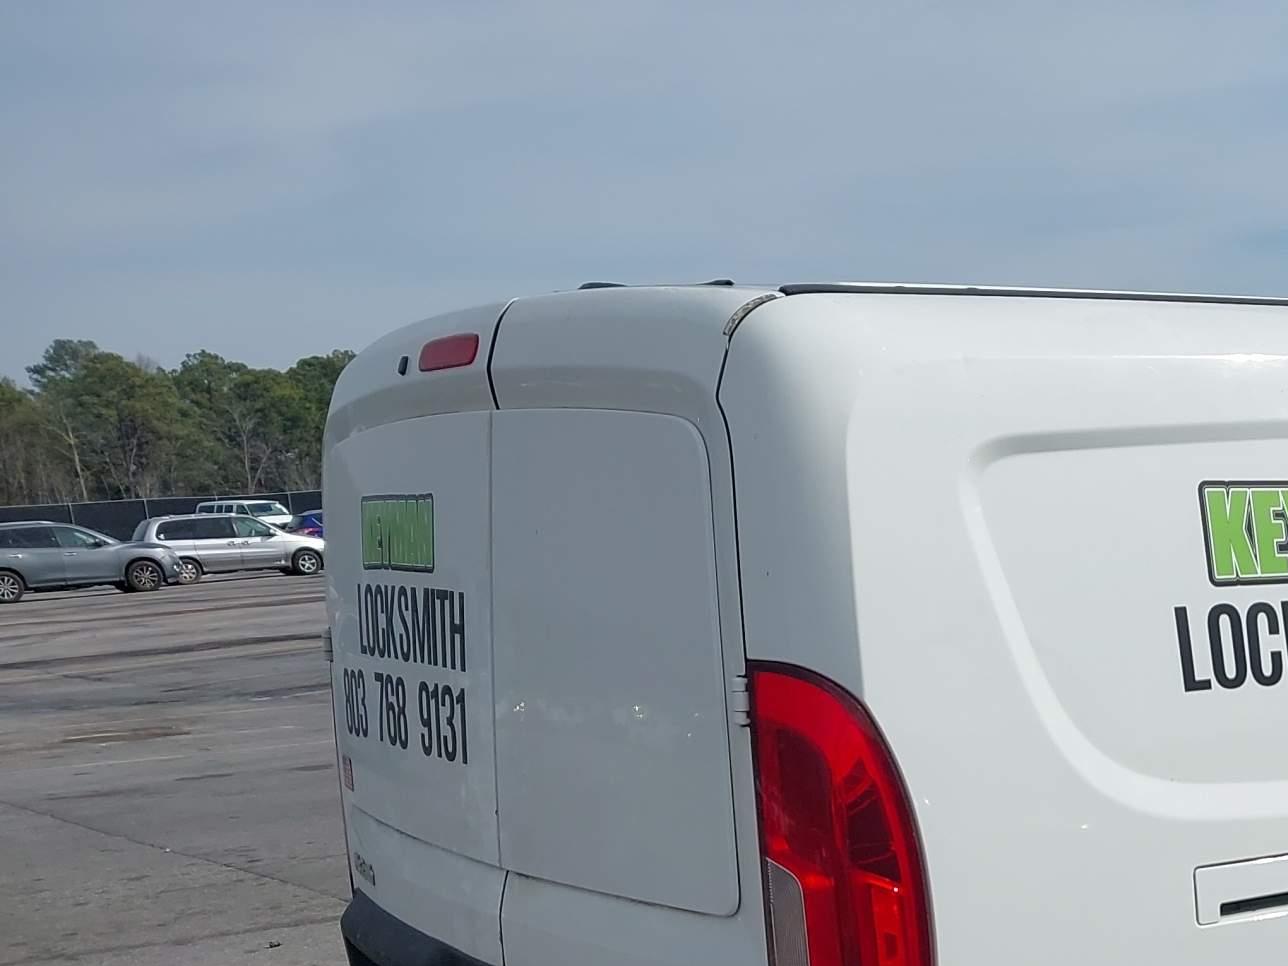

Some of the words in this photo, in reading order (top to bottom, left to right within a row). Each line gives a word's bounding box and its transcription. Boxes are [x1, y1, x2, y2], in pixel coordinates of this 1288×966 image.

[357, 583, 467, 673] LOCKSMITH
[343, 667, 369, 739] 803
[374, 671, 409, 750] 768
[418, 680, 468, 765] 9131
